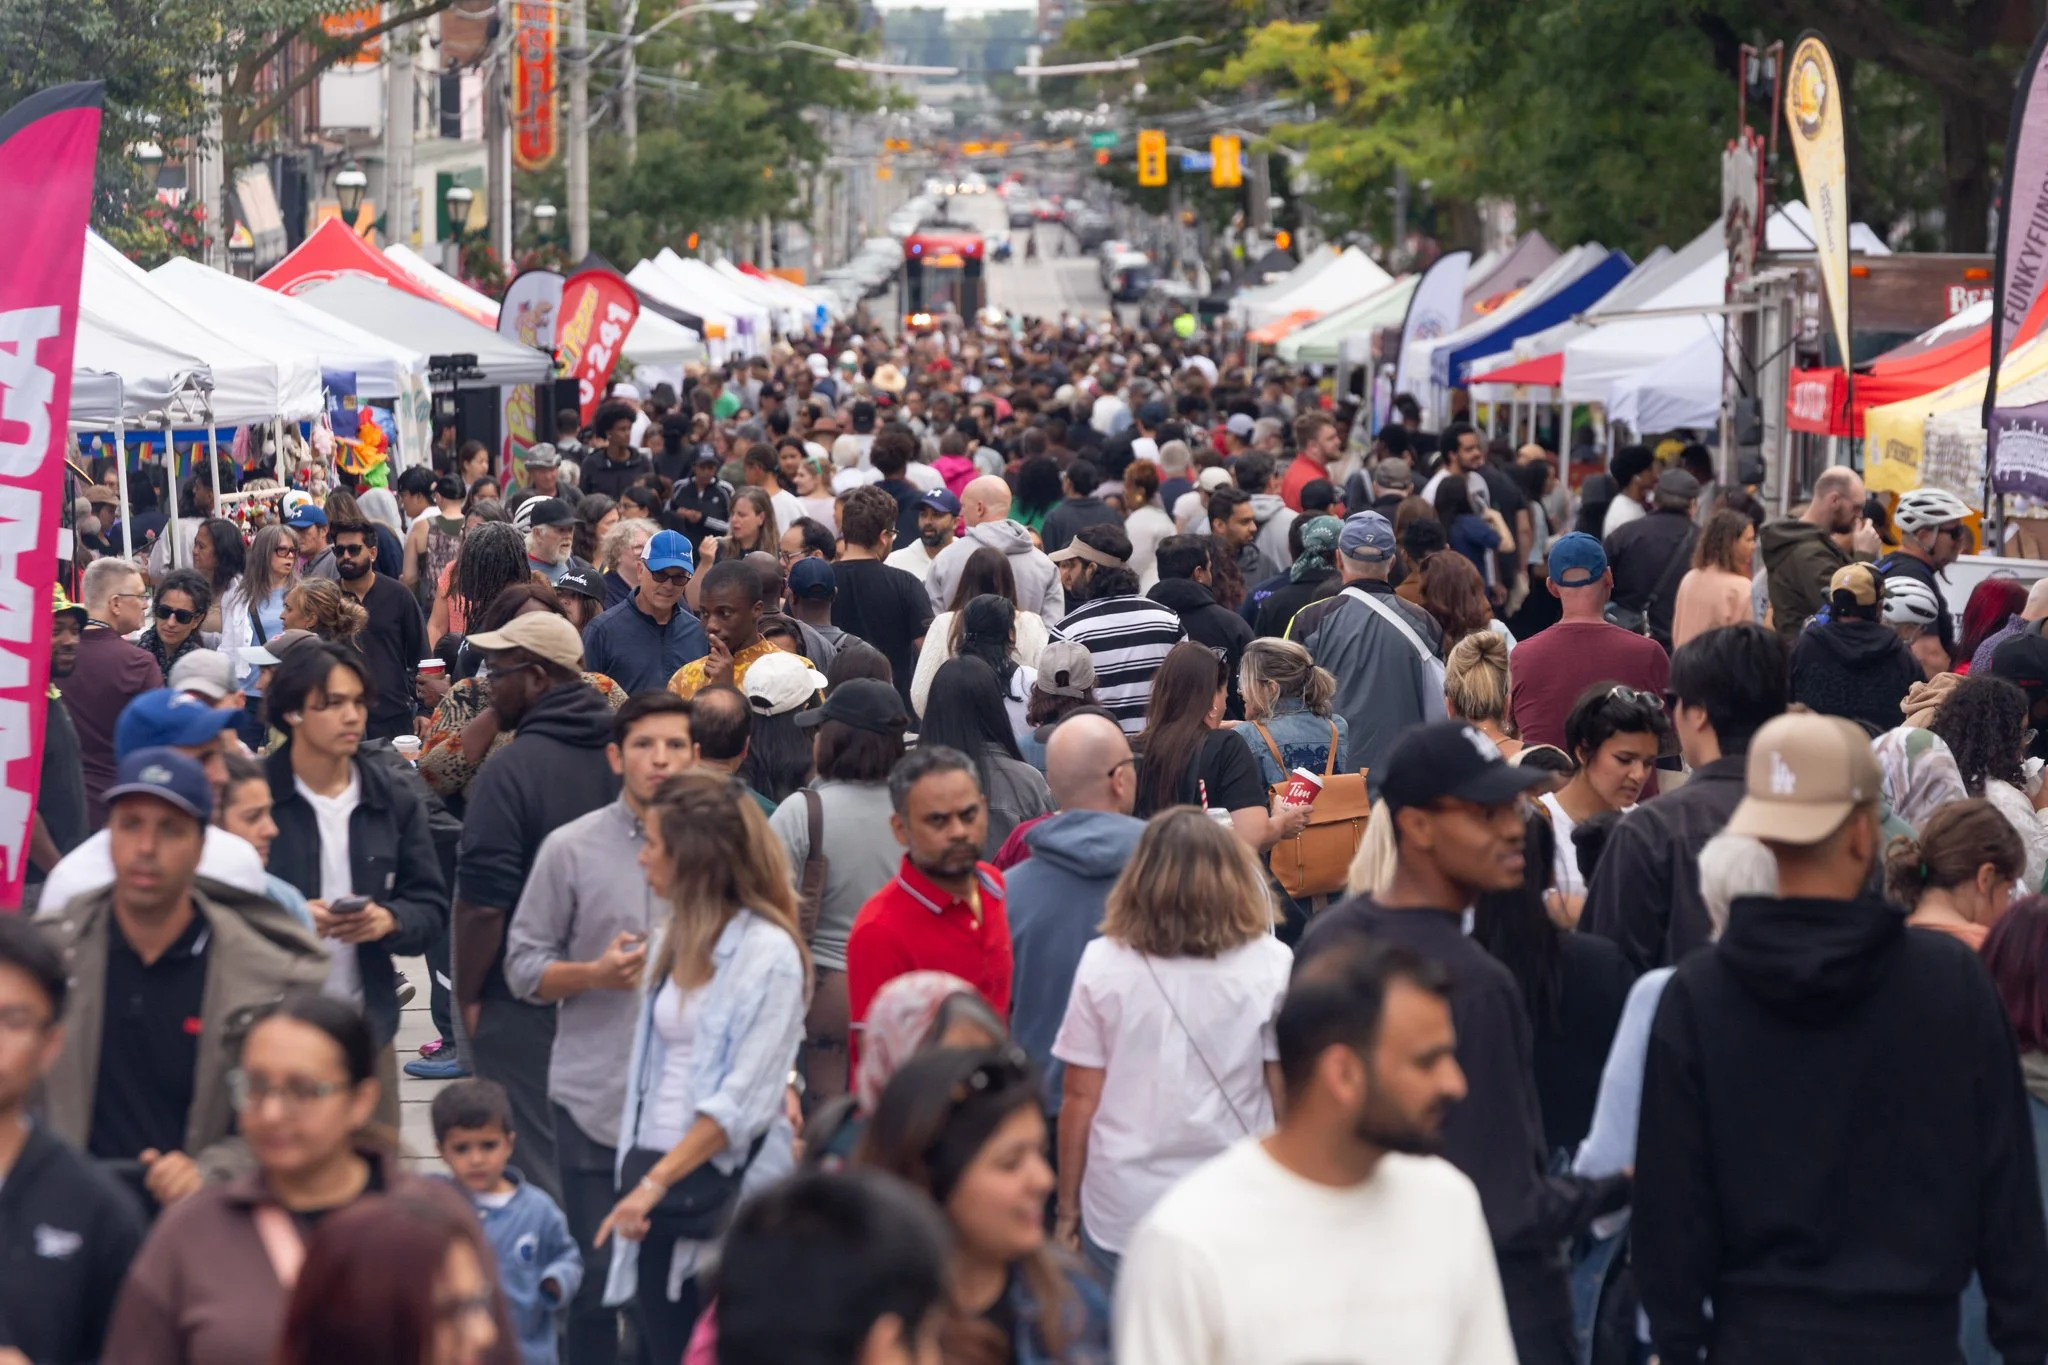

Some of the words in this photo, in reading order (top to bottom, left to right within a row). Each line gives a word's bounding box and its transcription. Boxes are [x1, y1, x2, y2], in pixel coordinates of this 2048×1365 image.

[2003, 172, 2048, 326] FUNKYFUN
[559, 572, 588, 587] Fender
[1288, 781, 1311, 799] Tim
